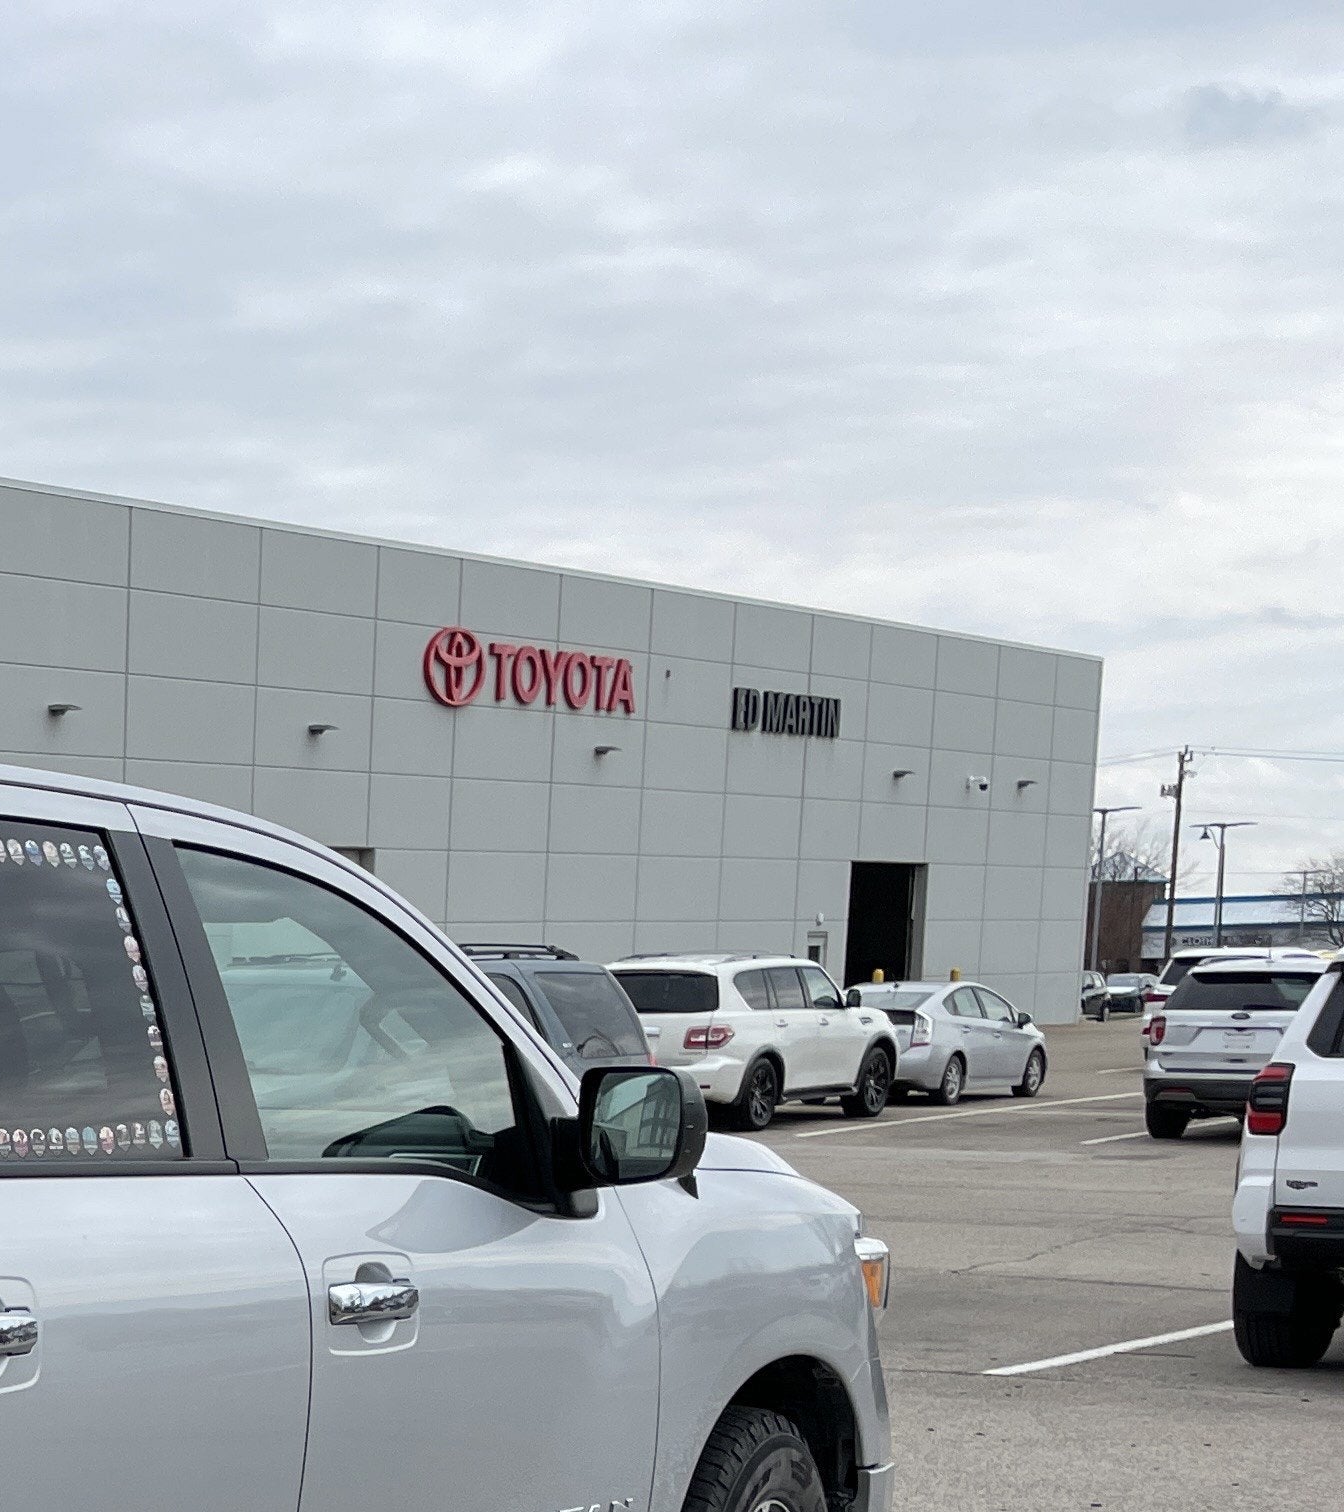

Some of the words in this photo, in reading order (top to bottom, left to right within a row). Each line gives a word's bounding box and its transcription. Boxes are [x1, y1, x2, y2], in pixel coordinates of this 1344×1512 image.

[489, 643, 635, 714] TOYOTA
[732, 687, 761, 731] ED
[762, 690, 841, 738] MARTIN
